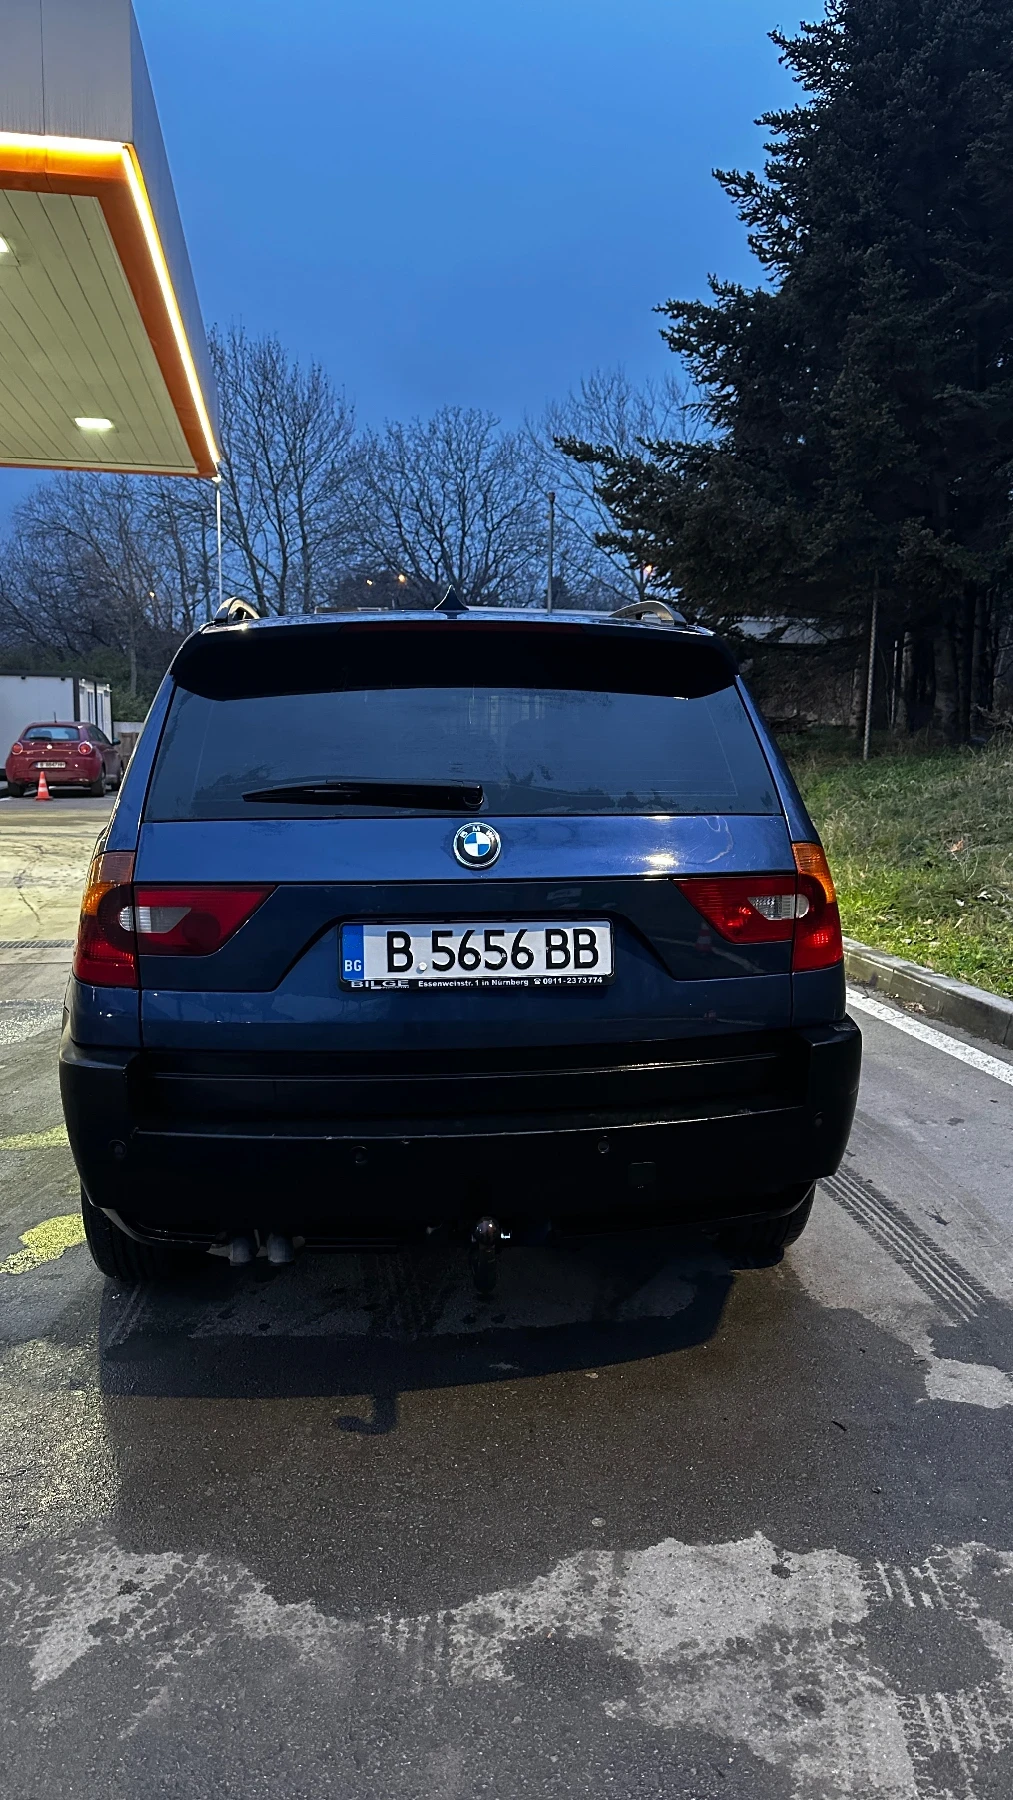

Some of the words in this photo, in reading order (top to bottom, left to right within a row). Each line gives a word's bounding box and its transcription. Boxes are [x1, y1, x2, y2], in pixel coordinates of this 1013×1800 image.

[460, 826, 495, 840] BMW
[386, 931, 414, 973] B
[432, 930, 535, 971] 5656
[545, 928, 599, 969] BB
[345, 960, 362, 972] BG
[351, 980, 409, 989] BILGE
[474, 979, 480, 987] 1
[482, 979, 490, 987] in
[491, 979, 529, 987] Nürnberg
